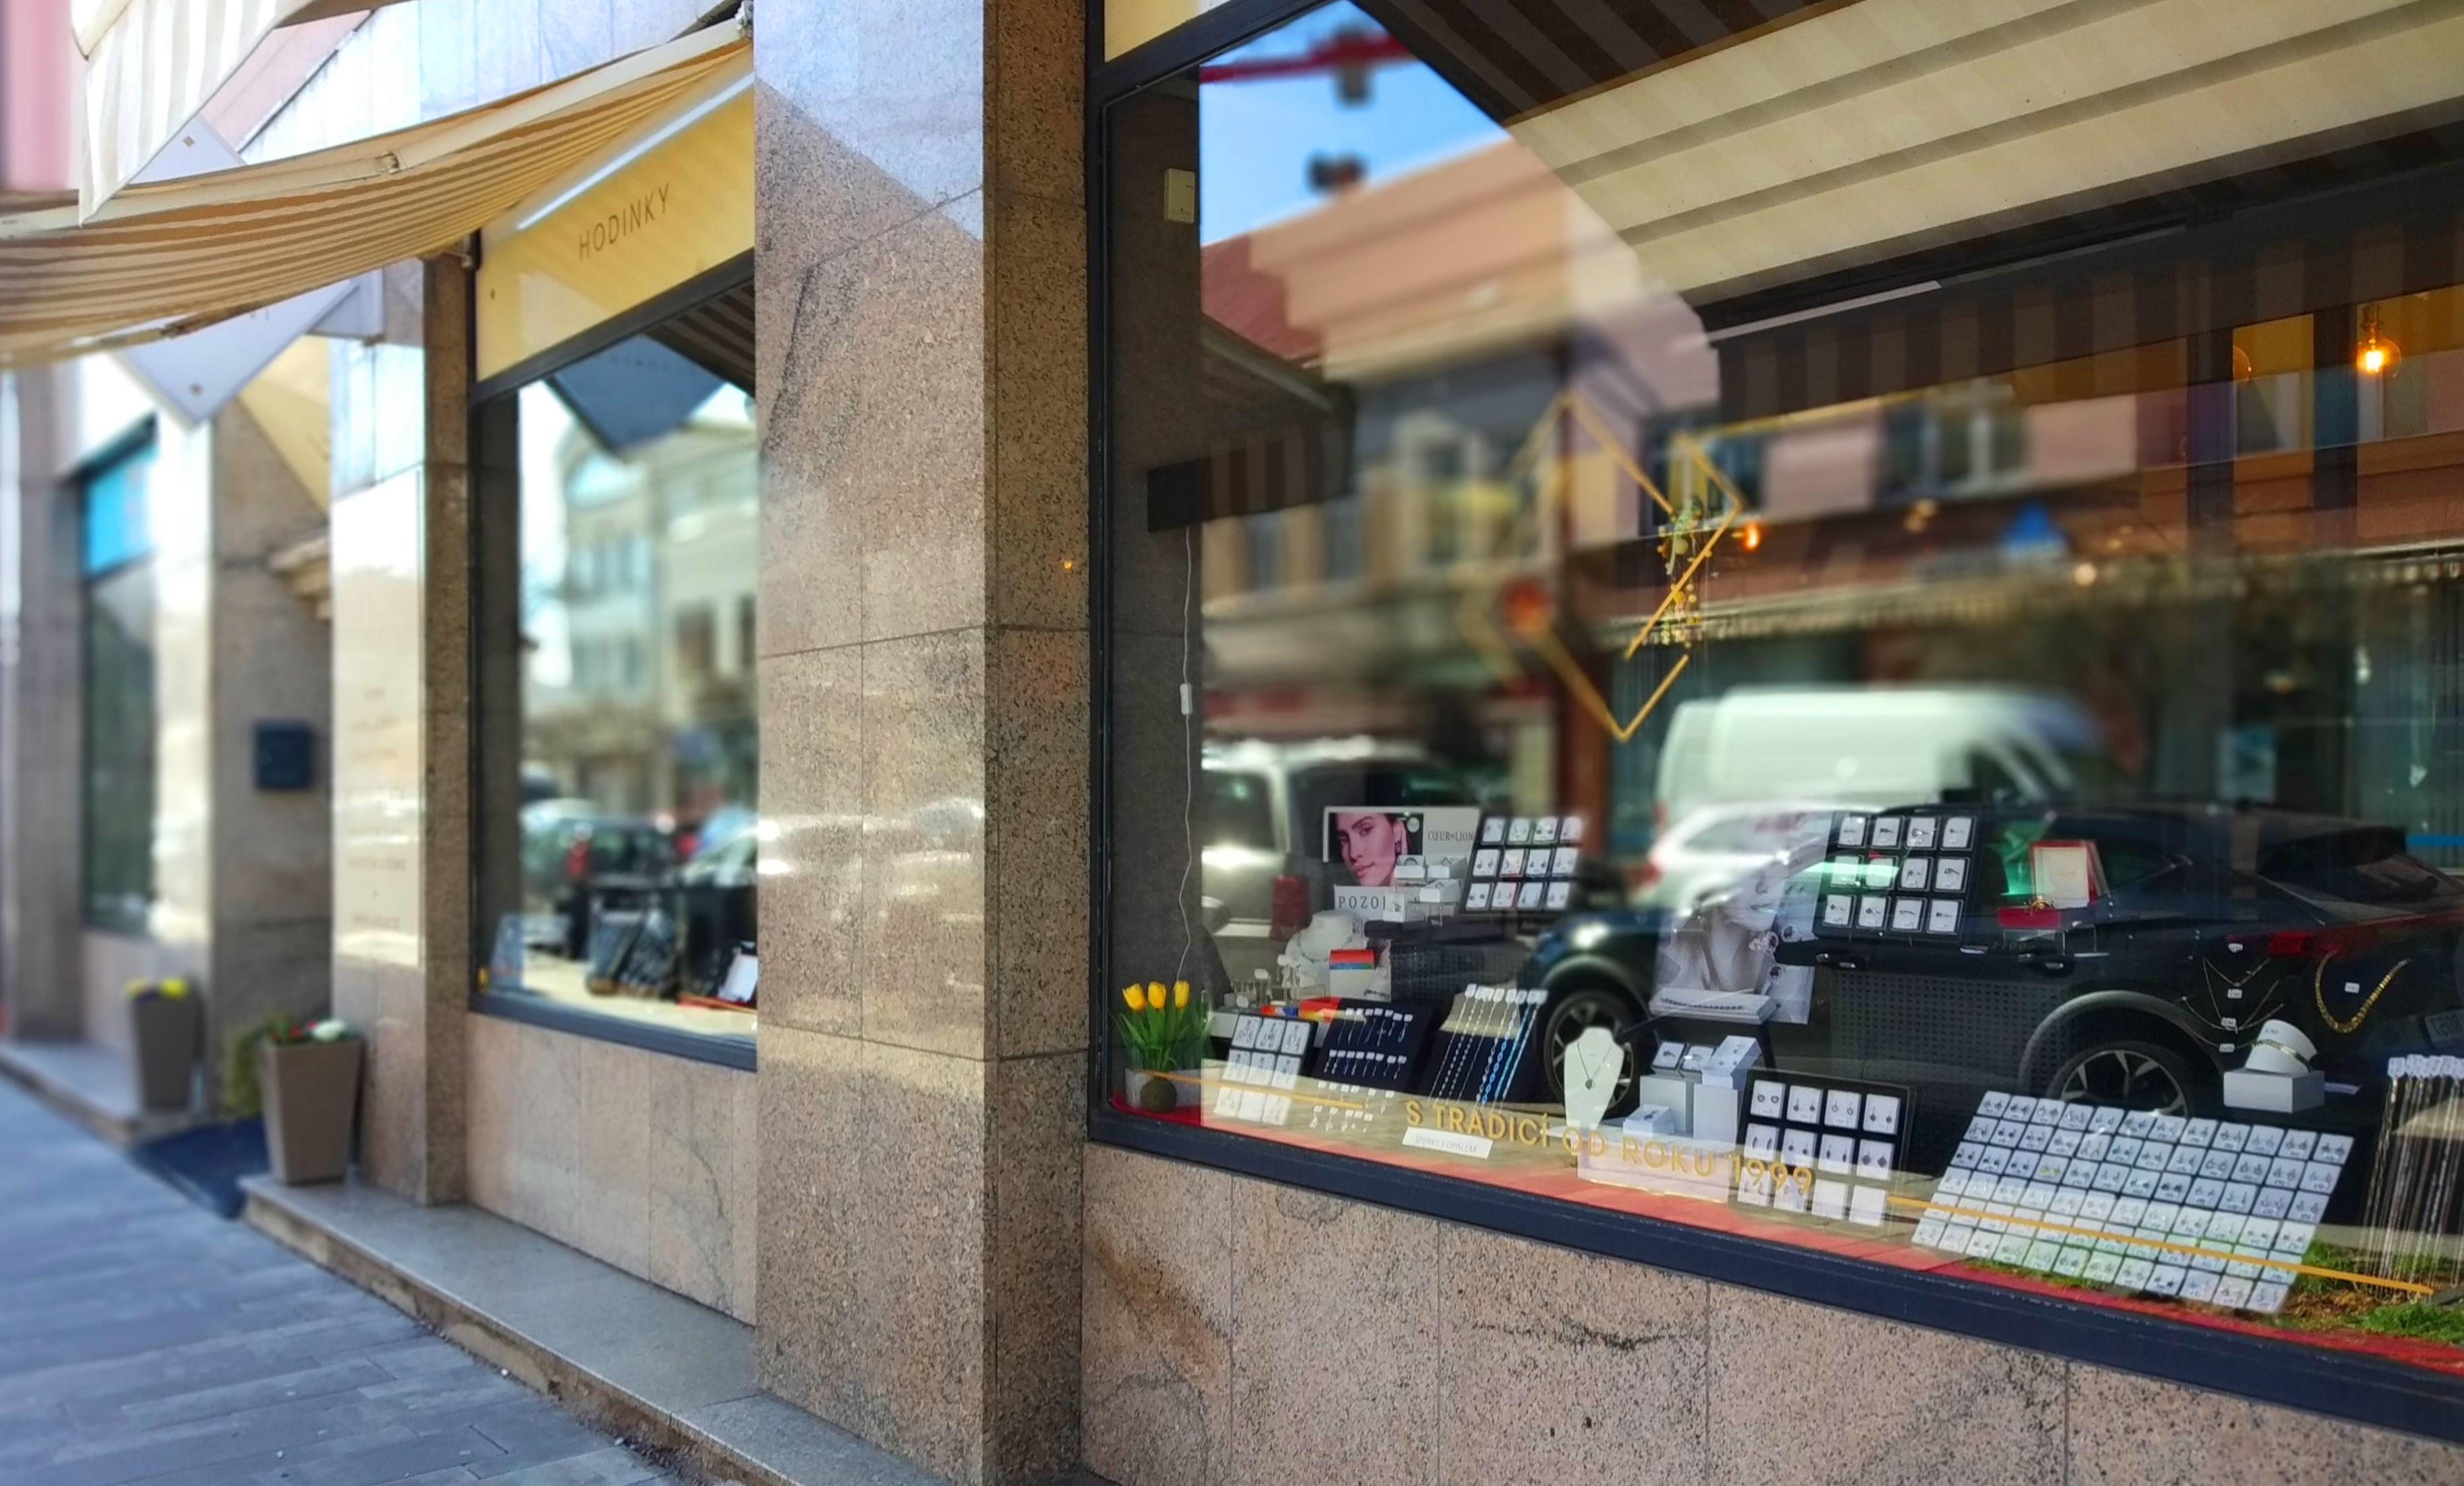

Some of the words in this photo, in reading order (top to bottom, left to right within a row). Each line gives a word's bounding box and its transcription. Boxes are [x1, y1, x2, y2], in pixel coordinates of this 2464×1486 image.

[579, 182, 669, 261] HODINKY
[1455, 831, 1474, 841] LION
[1339, 896, 1385, 909] POZO
[1406, 1100, 1422, 1126] S
[1434, 1102, 1550, 1147] TRADICÍ
[1562, 1126, 1605, 1157] OD
[1623, 1137, 1715, 1178] ROKU
[1730, 1153, 1814, 1194] 1999
